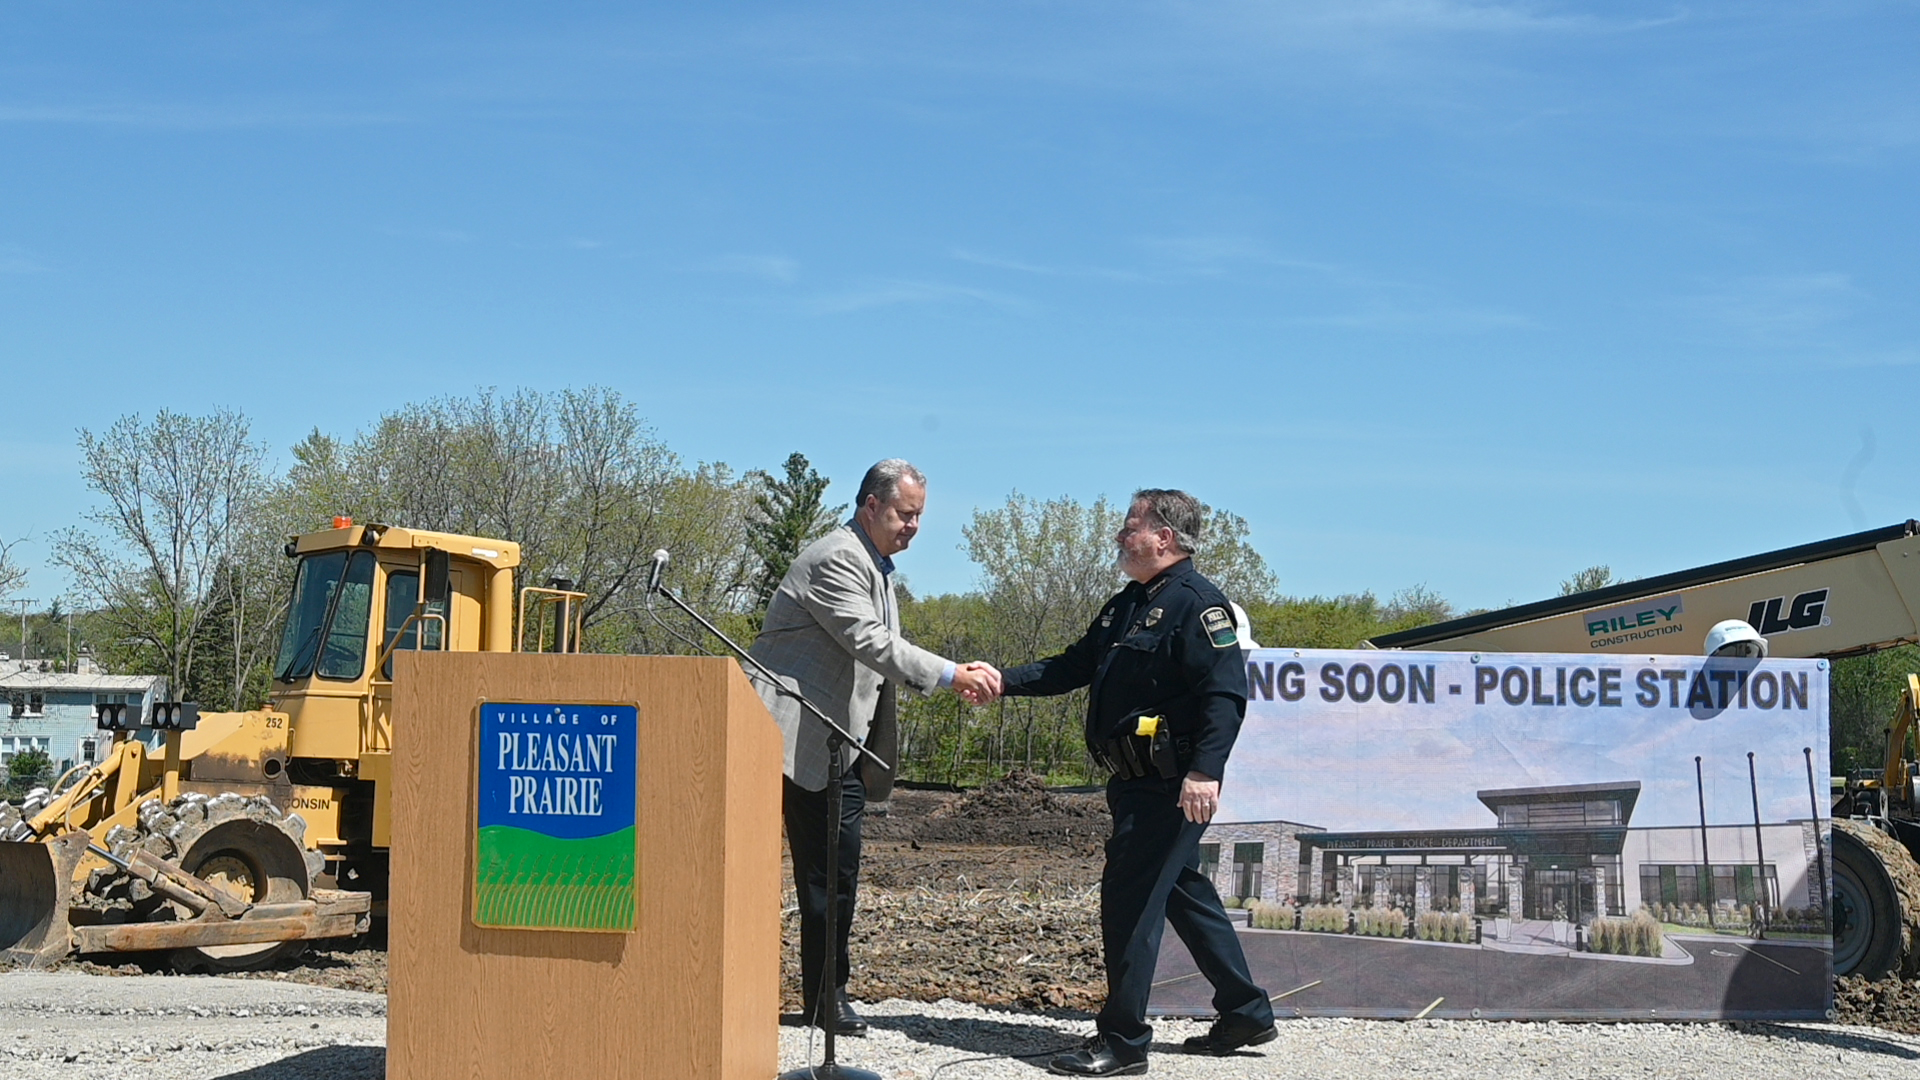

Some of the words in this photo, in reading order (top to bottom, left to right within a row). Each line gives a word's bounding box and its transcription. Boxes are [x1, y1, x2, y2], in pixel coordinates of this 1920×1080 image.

[1588, 605, 1678, 636] RILEY
[1590, 623, 1683, 649] CONSTRUCTION
[1319, 662, 1436, 704] SOON
[1474, 665, 1622, 707] POLICE
[1635, 668, 1809, 710] STATION
[266, 716, 283, 729] 252
[497, 712, 580, 725] VILLAGE
[600, 714, 618, 725] OF
[497, 732, 618, 773] PLEASANT
[508, 775, 603, 816] PRAIRIE
[1402, 838, 1434, 848] POLICE
[1441, 836, 1497, 848] DEPARTMENT
